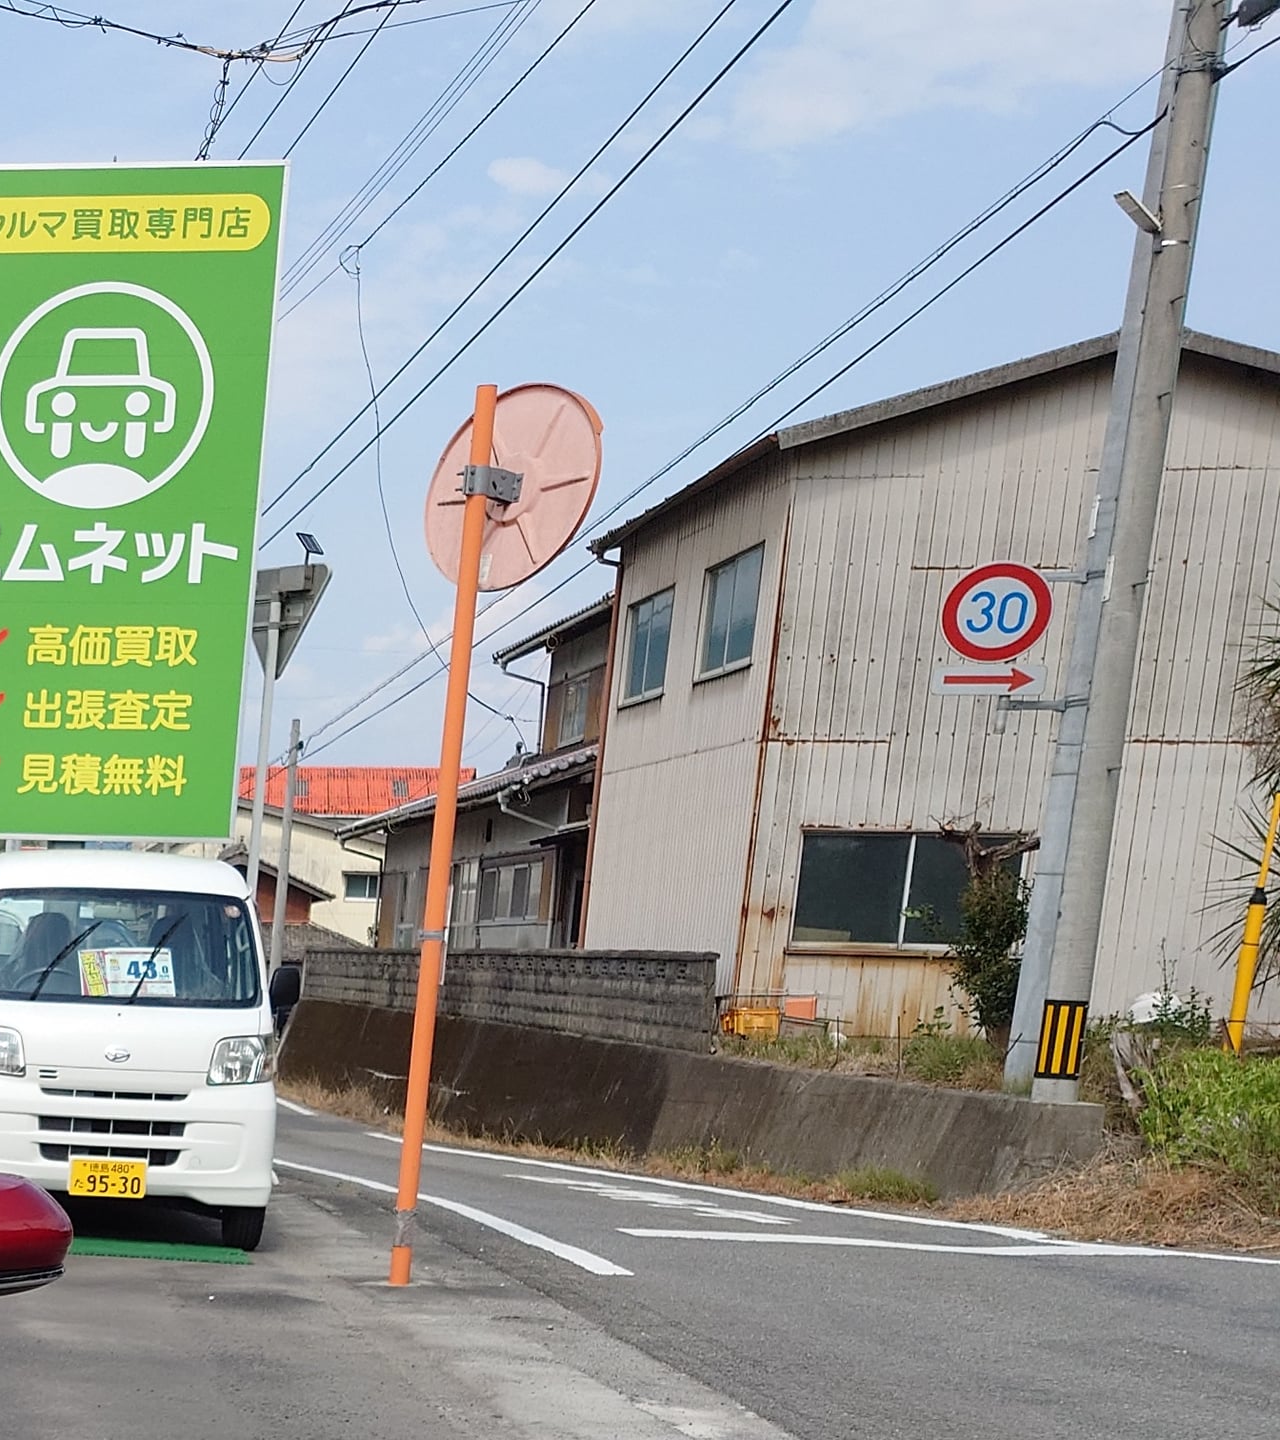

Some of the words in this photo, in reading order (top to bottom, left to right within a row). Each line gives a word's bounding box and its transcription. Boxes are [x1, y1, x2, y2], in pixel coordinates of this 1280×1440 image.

[965, 589, 1030, 634] 30
[26, 623, 199, 668] 高価買取
[22, 688, 193, 731] 出張査定
[16, 753, 188, 797] 見積無料
[86, 1174, 141, 1194] 95-30
